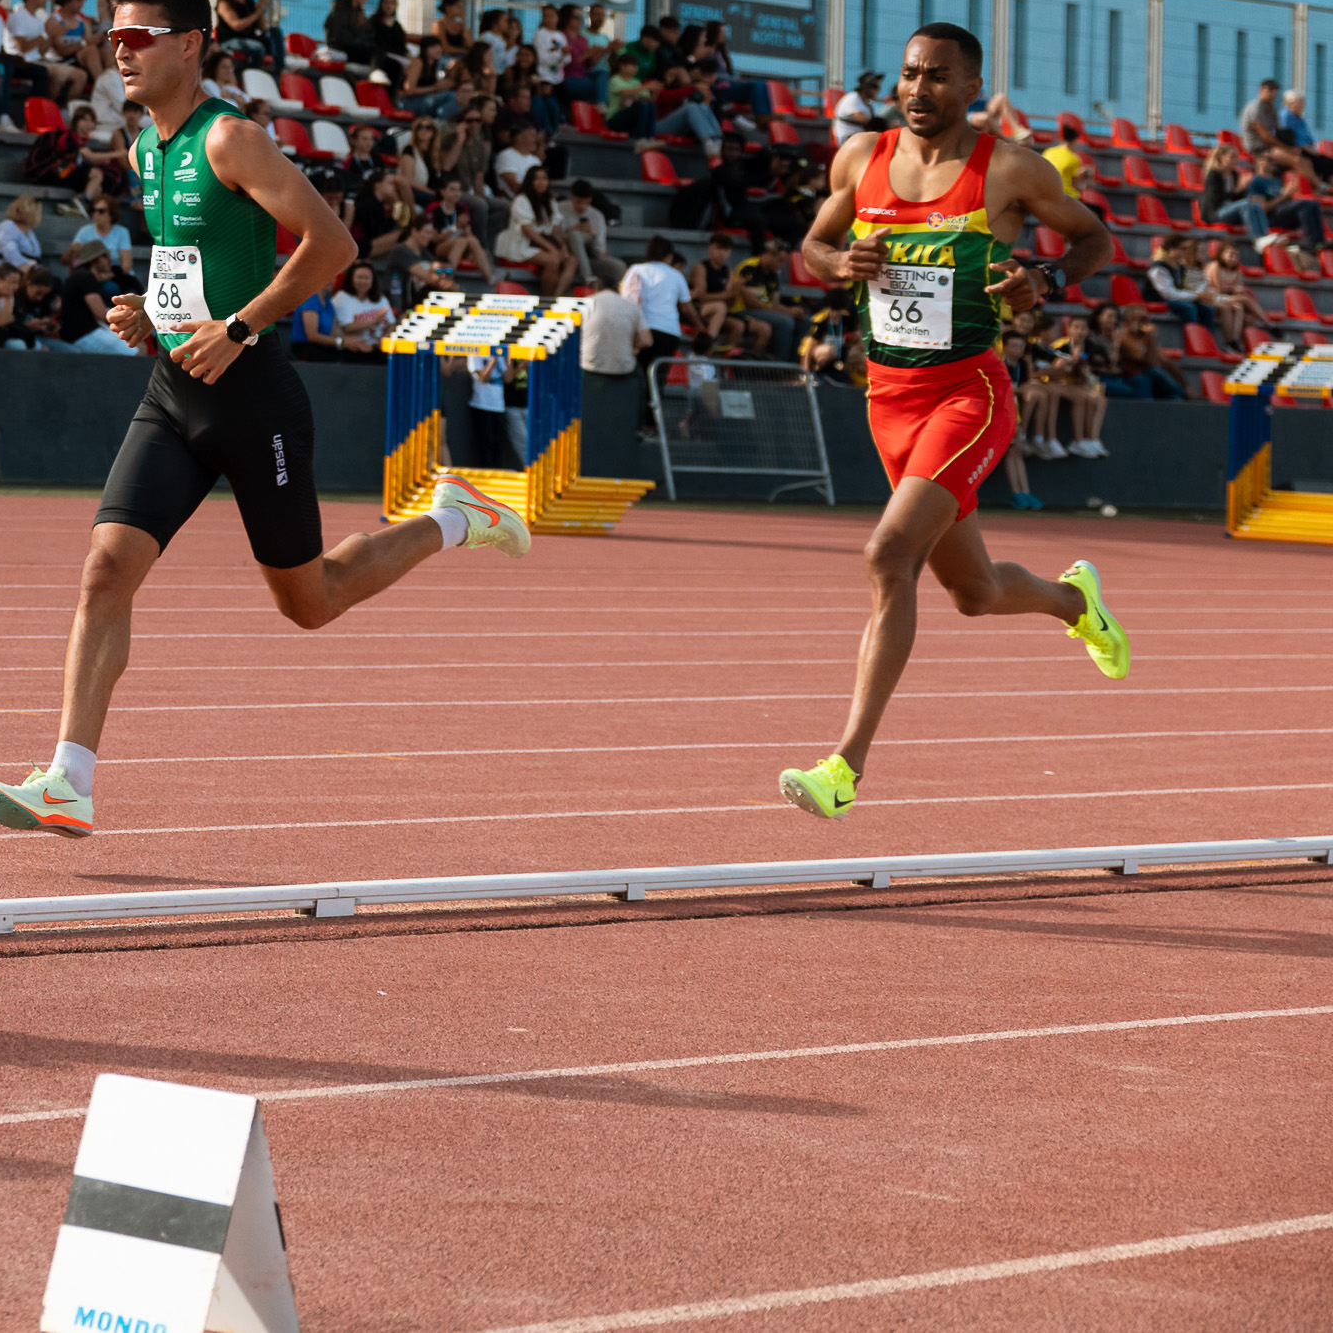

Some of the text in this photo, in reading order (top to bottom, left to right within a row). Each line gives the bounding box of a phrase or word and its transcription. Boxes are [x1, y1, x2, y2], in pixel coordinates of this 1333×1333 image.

[866, 207, 897, 216] BROOKS
[885, 241, 957, 266] KILA
[880, 269, 936, 282] MEETING
[889, 280, 917, 290] IBIZA
[157, 283, 182, 308] 68
[889, 299, 923, 324] 66
[271, 434, 287, 472] rasán
